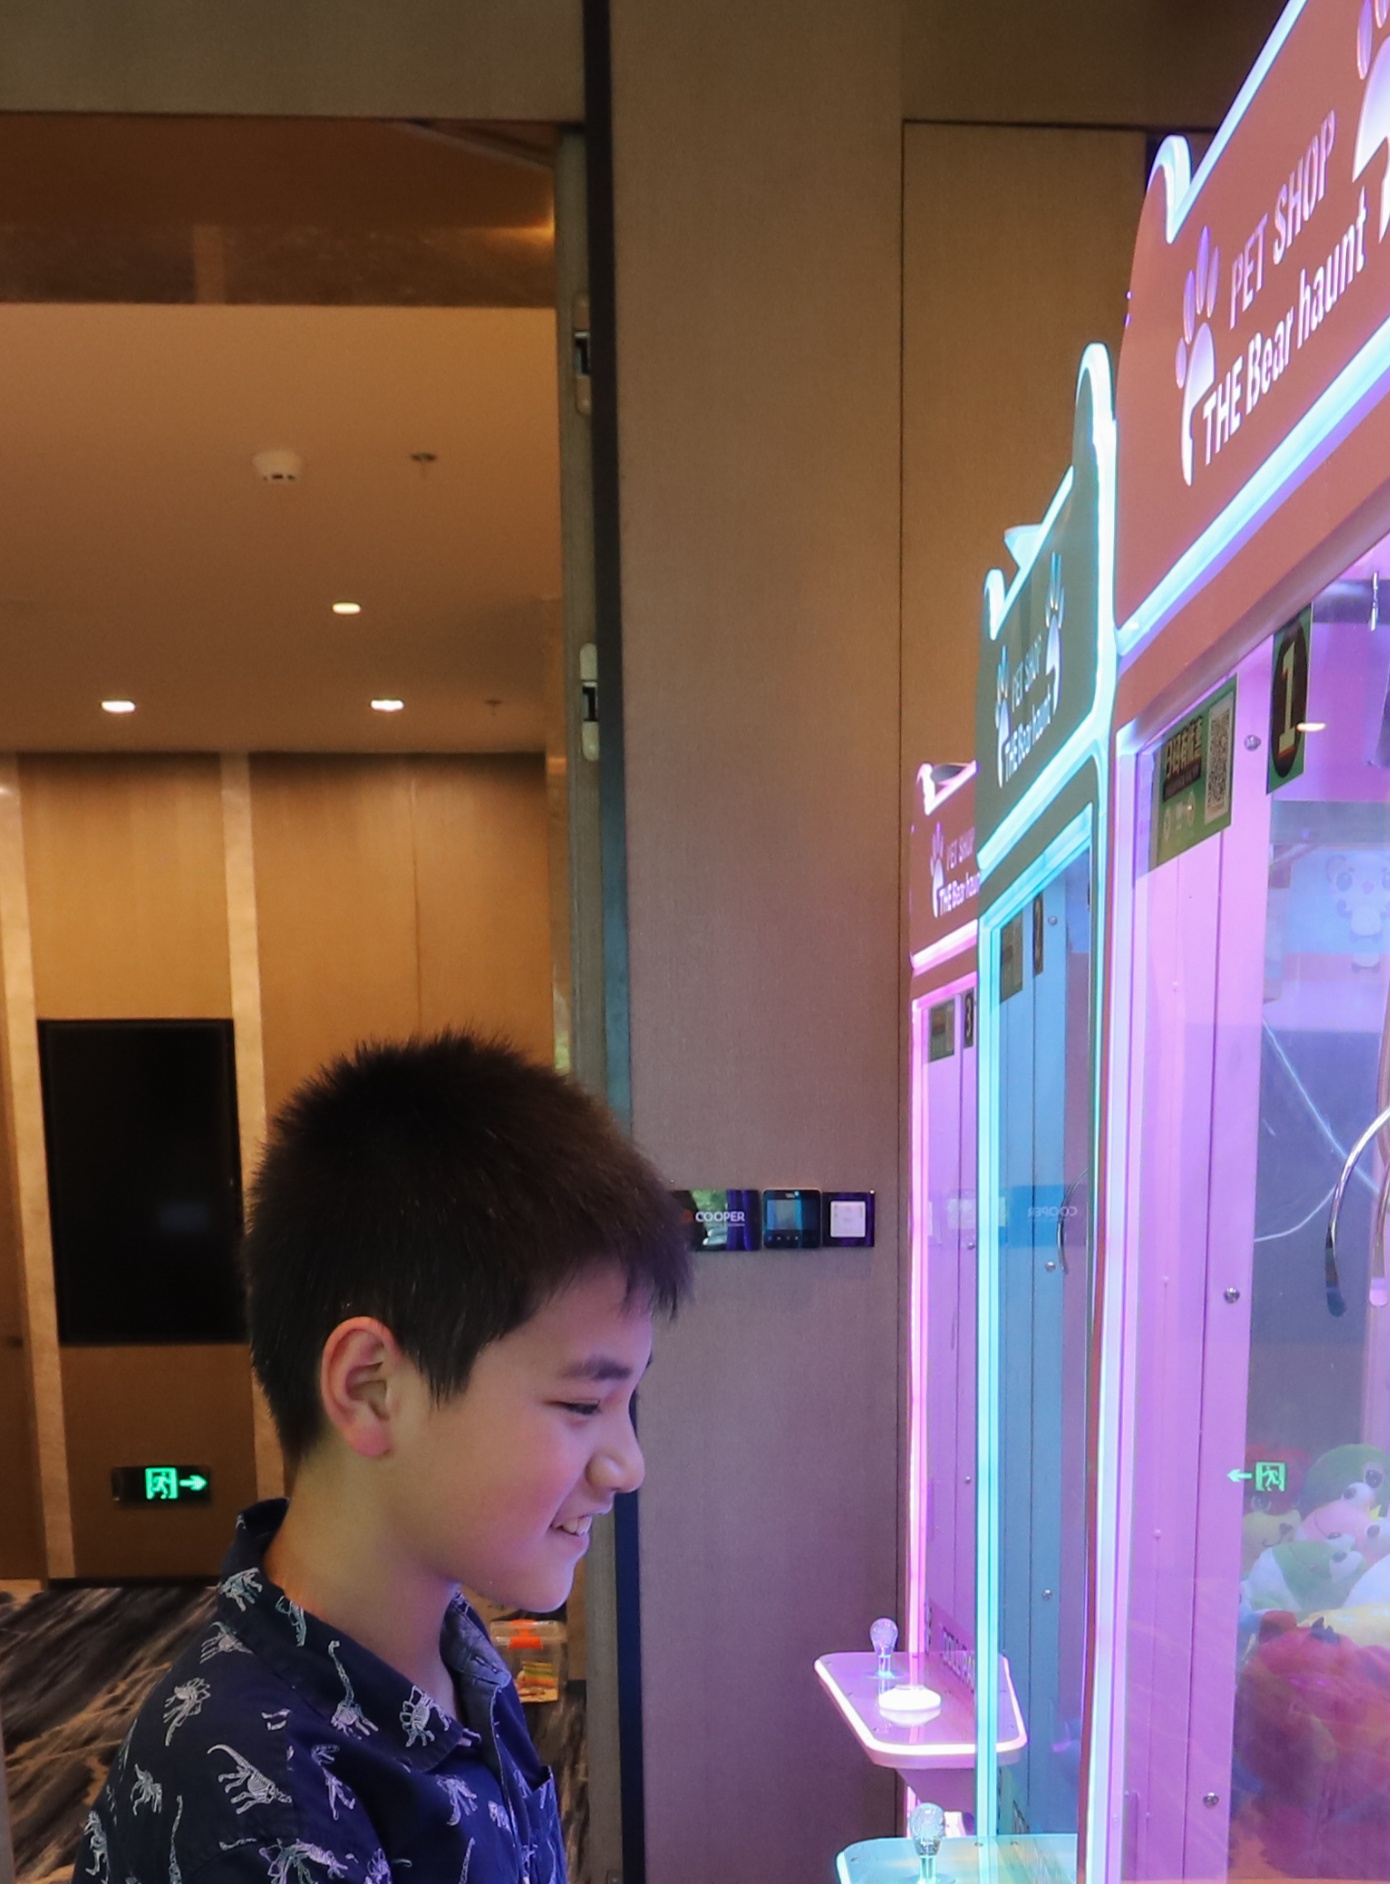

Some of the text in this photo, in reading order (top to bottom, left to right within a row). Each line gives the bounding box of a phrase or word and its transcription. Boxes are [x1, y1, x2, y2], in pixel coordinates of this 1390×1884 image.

[1229, 109, 1337, 330] PET SHOP
[1202, 185, 1367, 466] THE Bear haunt
[1278, 641, 1297, 756] 1
[695, 1211, 745, 1222] COOPER
